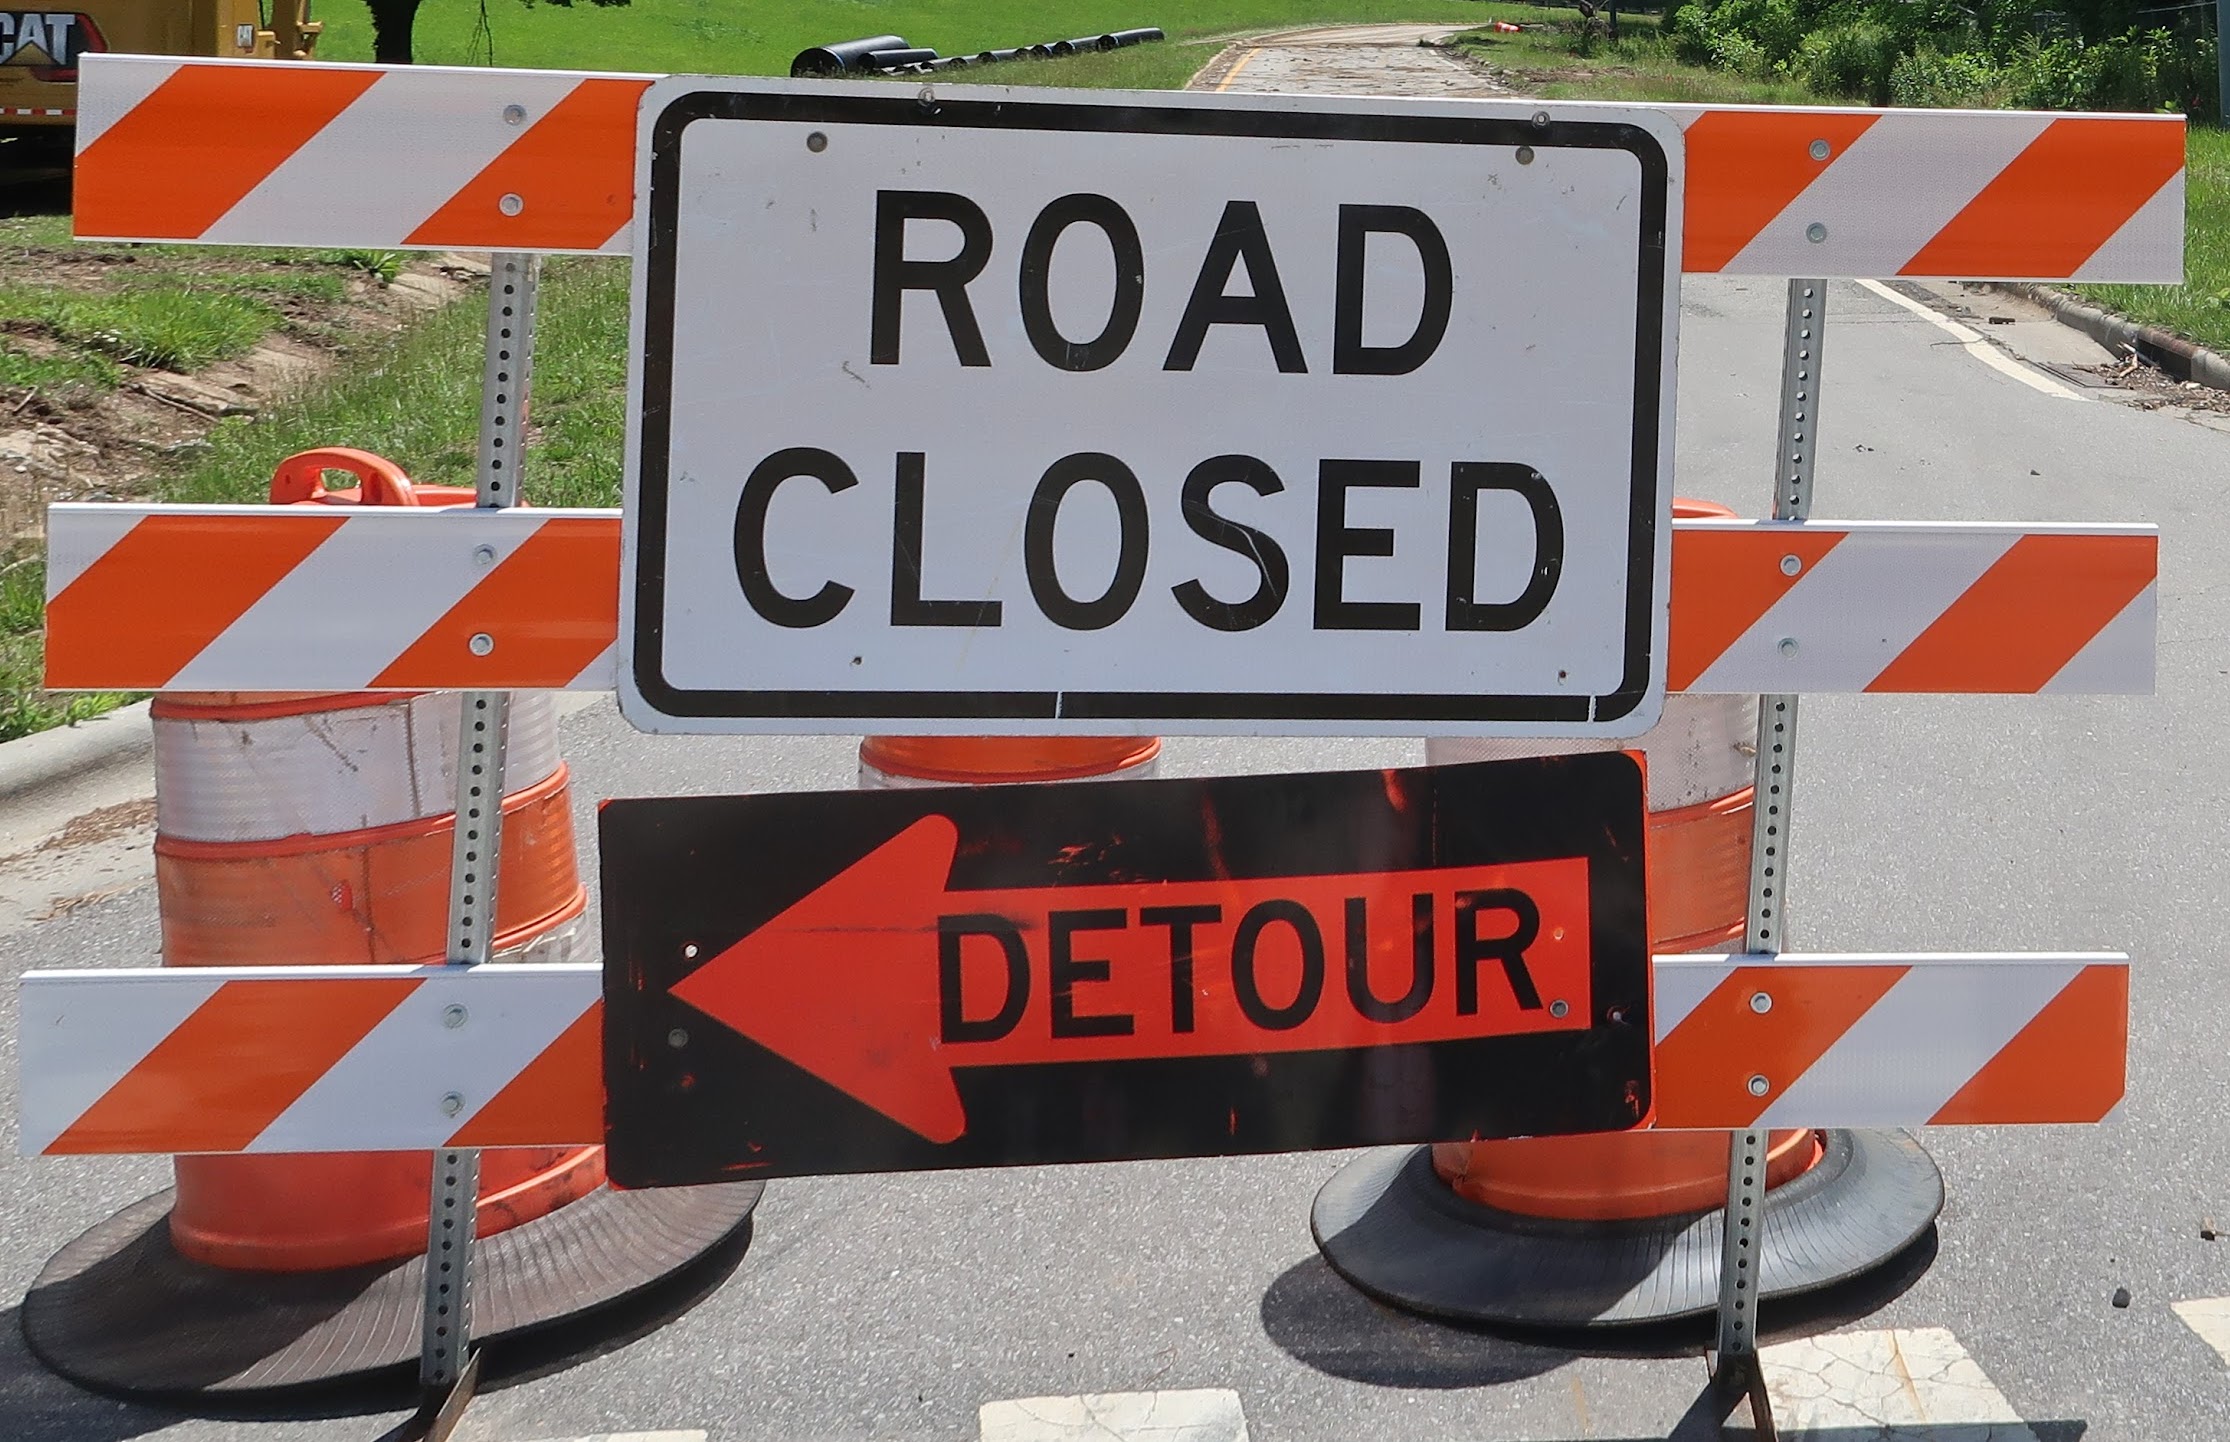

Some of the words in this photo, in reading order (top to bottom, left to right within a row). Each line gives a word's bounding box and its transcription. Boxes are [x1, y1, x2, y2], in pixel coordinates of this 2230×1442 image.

[871, 190, 1453, 375] ROAD
[734, 447, 1564, 632] CLOSED
[935, 887, 1544, 1044] DETOUR
